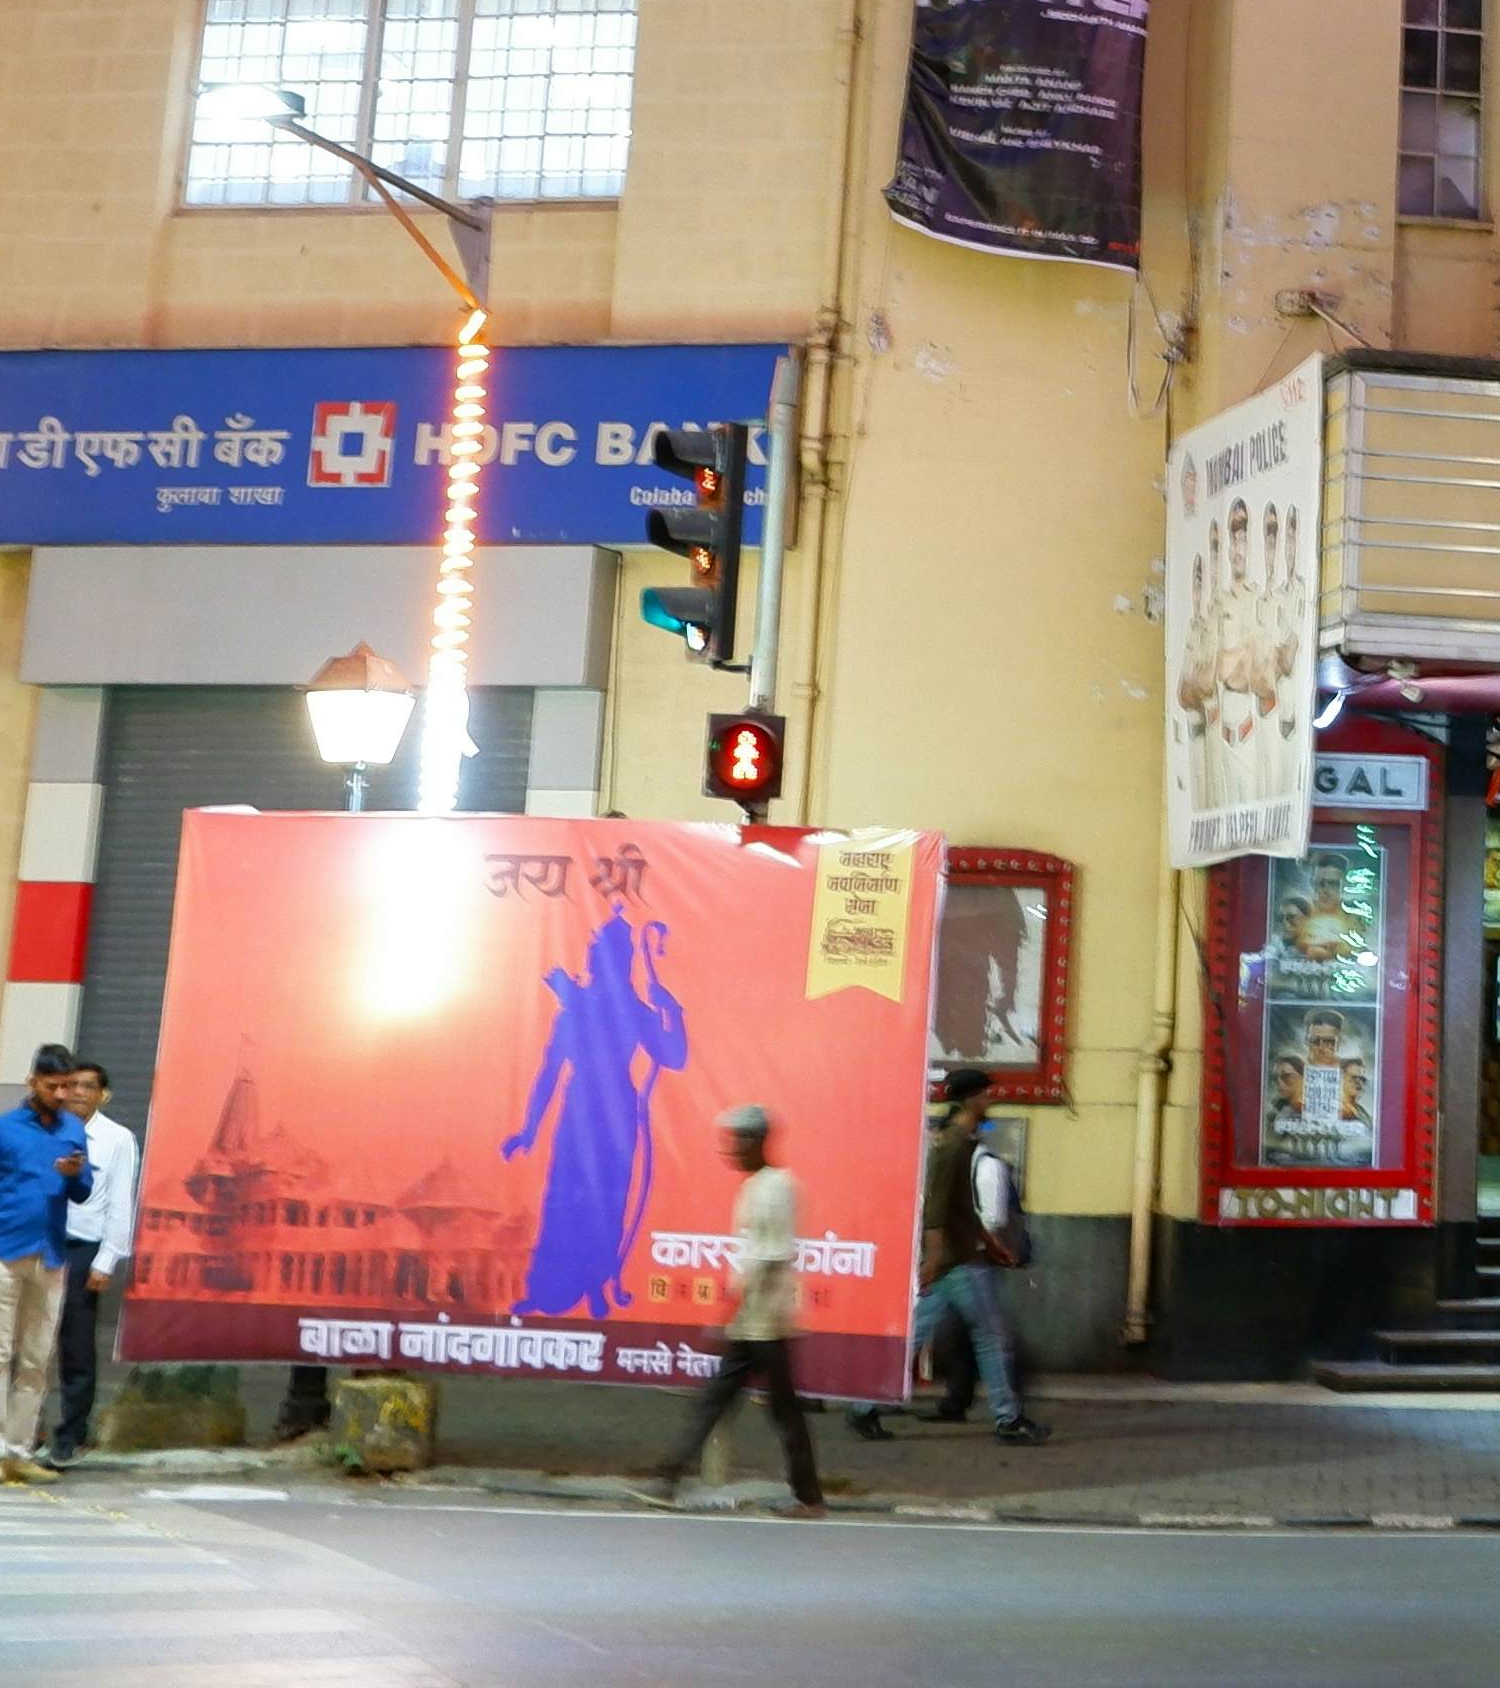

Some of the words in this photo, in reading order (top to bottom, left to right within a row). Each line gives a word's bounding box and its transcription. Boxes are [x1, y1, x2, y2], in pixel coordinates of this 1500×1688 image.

[1248, 418, 1288, 479] POLICE
[484, 853, 573, 900] जय
[589, 843, 651, 907] श्री
[299, 1318, 393, 1360] बाळा
[616, 1341, 674, 1375] मनसे
